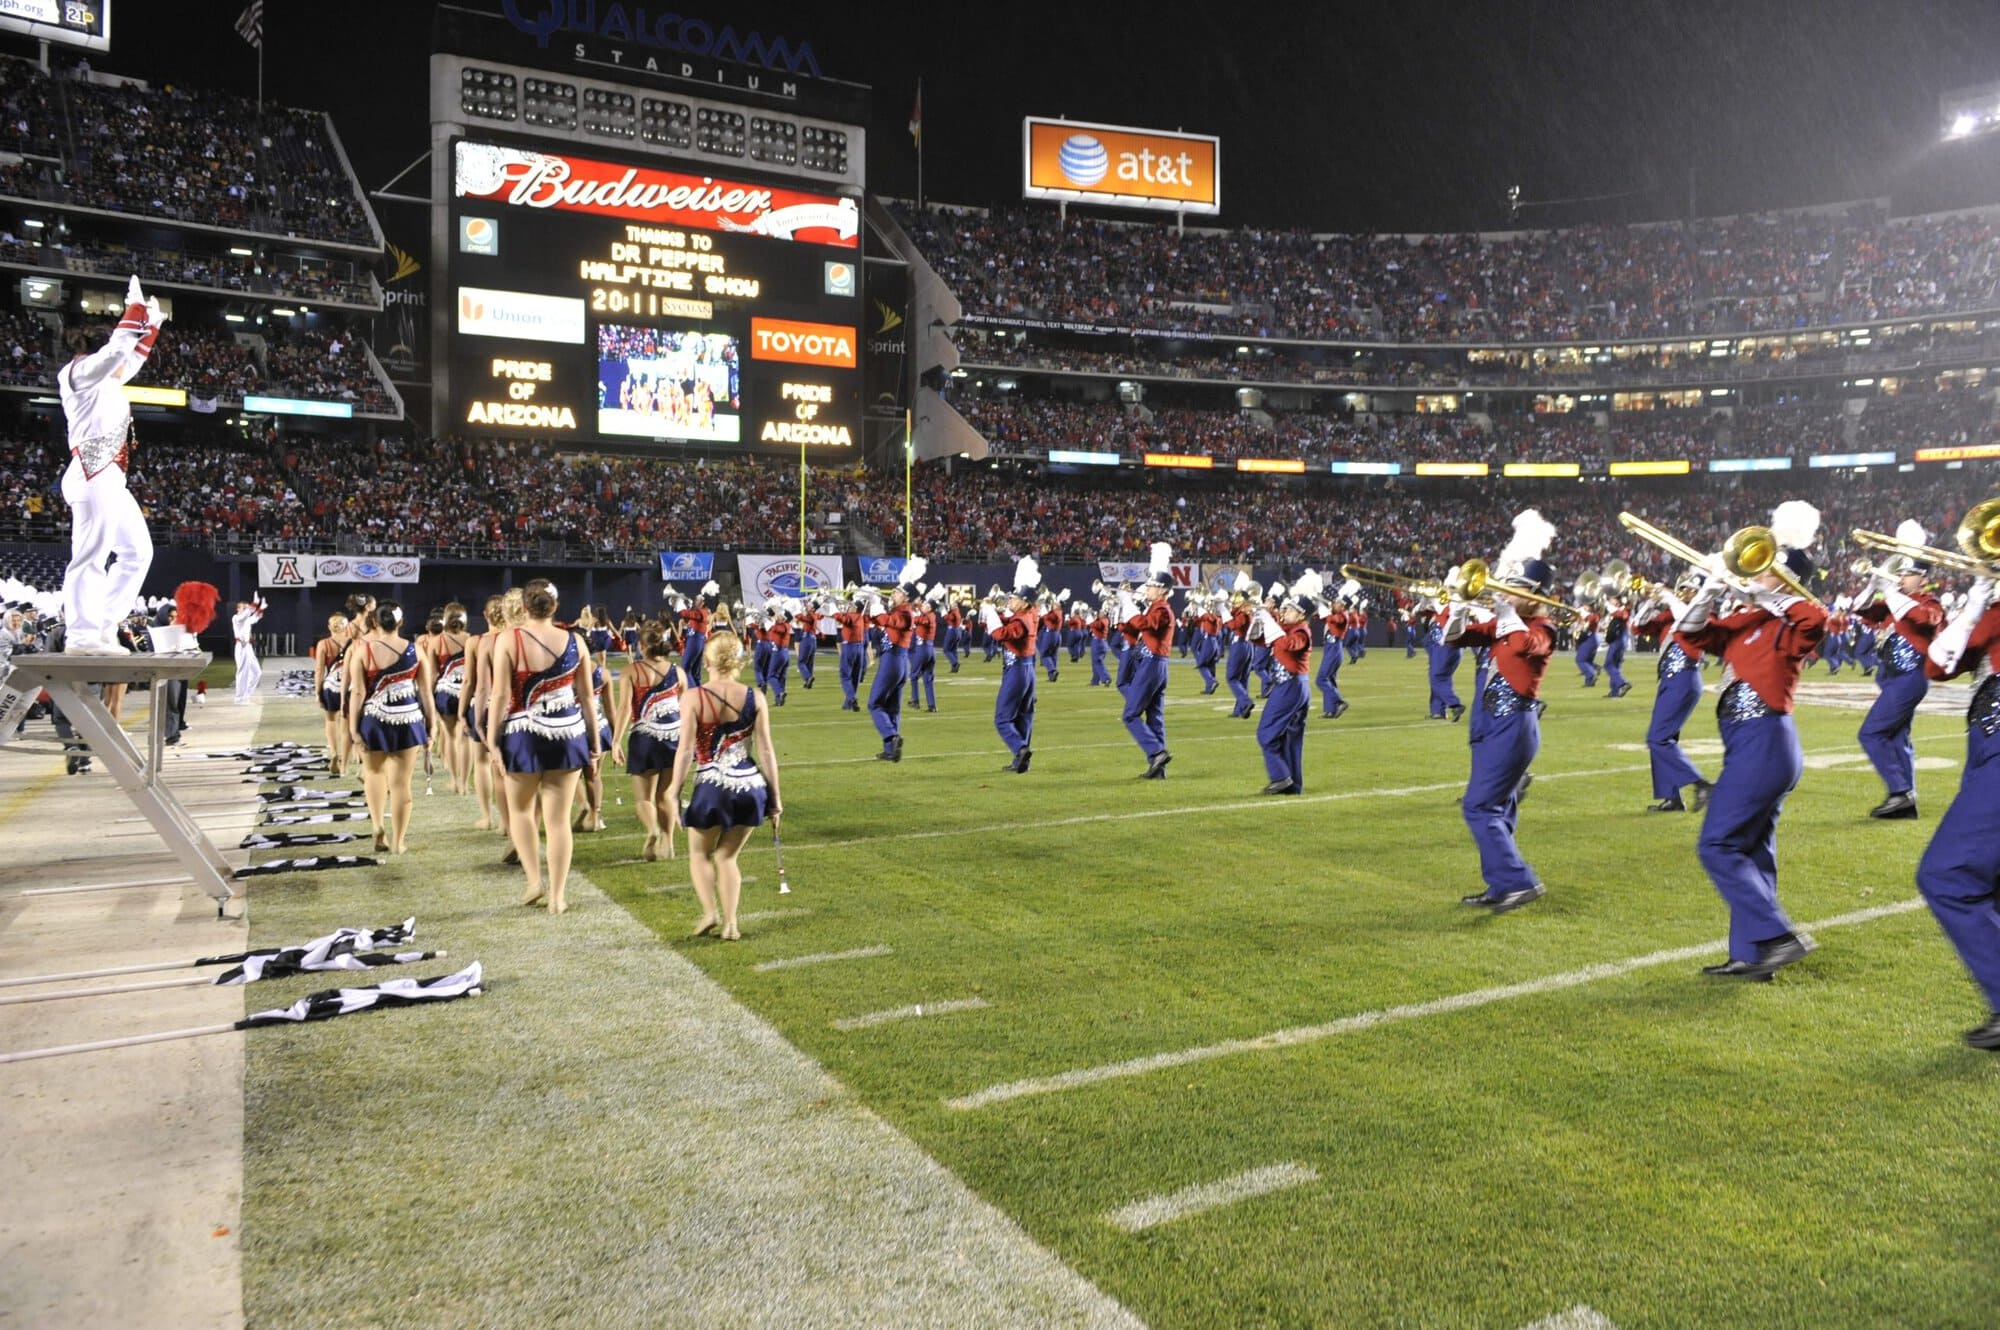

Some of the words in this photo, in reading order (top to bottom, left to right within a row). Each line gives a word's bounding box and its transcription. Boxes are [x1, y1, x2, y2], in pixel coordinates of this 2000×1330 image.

[0, 0, 44, 17] ph.org
[575, 44, 797, 97] STADIUM
[1117, 147, 1193, 187] at&t
[500, 153, 772, 215] Budweiser
[625, 225, 686, 249] THANKS
[691, 233, 713, 251] TO
[611, 242, 642, 264] DR
[648, 247, 725, 274] PEPPER
[580, 260, 693, 291] HALFTIME
[705, 275, 760, 298] SHOW
[592, 287, 657, 316] 20:11
[492, 306, 543, 325] Union
[757, 330, 852, 359] TOYOTA
[867, 339, 906, 356] Sprint
[492, 359, 552, 381] PRIDE
[509, 382, 536, 400] OF
[781, 382, 832, 403] PRIDE
[466, 401, 577, 429] ARIZONA
[795, 404, 818, 420] OF
[760, 421, 852, 446] ARIZONA
[273, 557, 304, 584] A
[764, 563, 799, 579] PACIFIC
[801, 566, 820, 579] IFE
[1171, 565, 1192, 587] N
